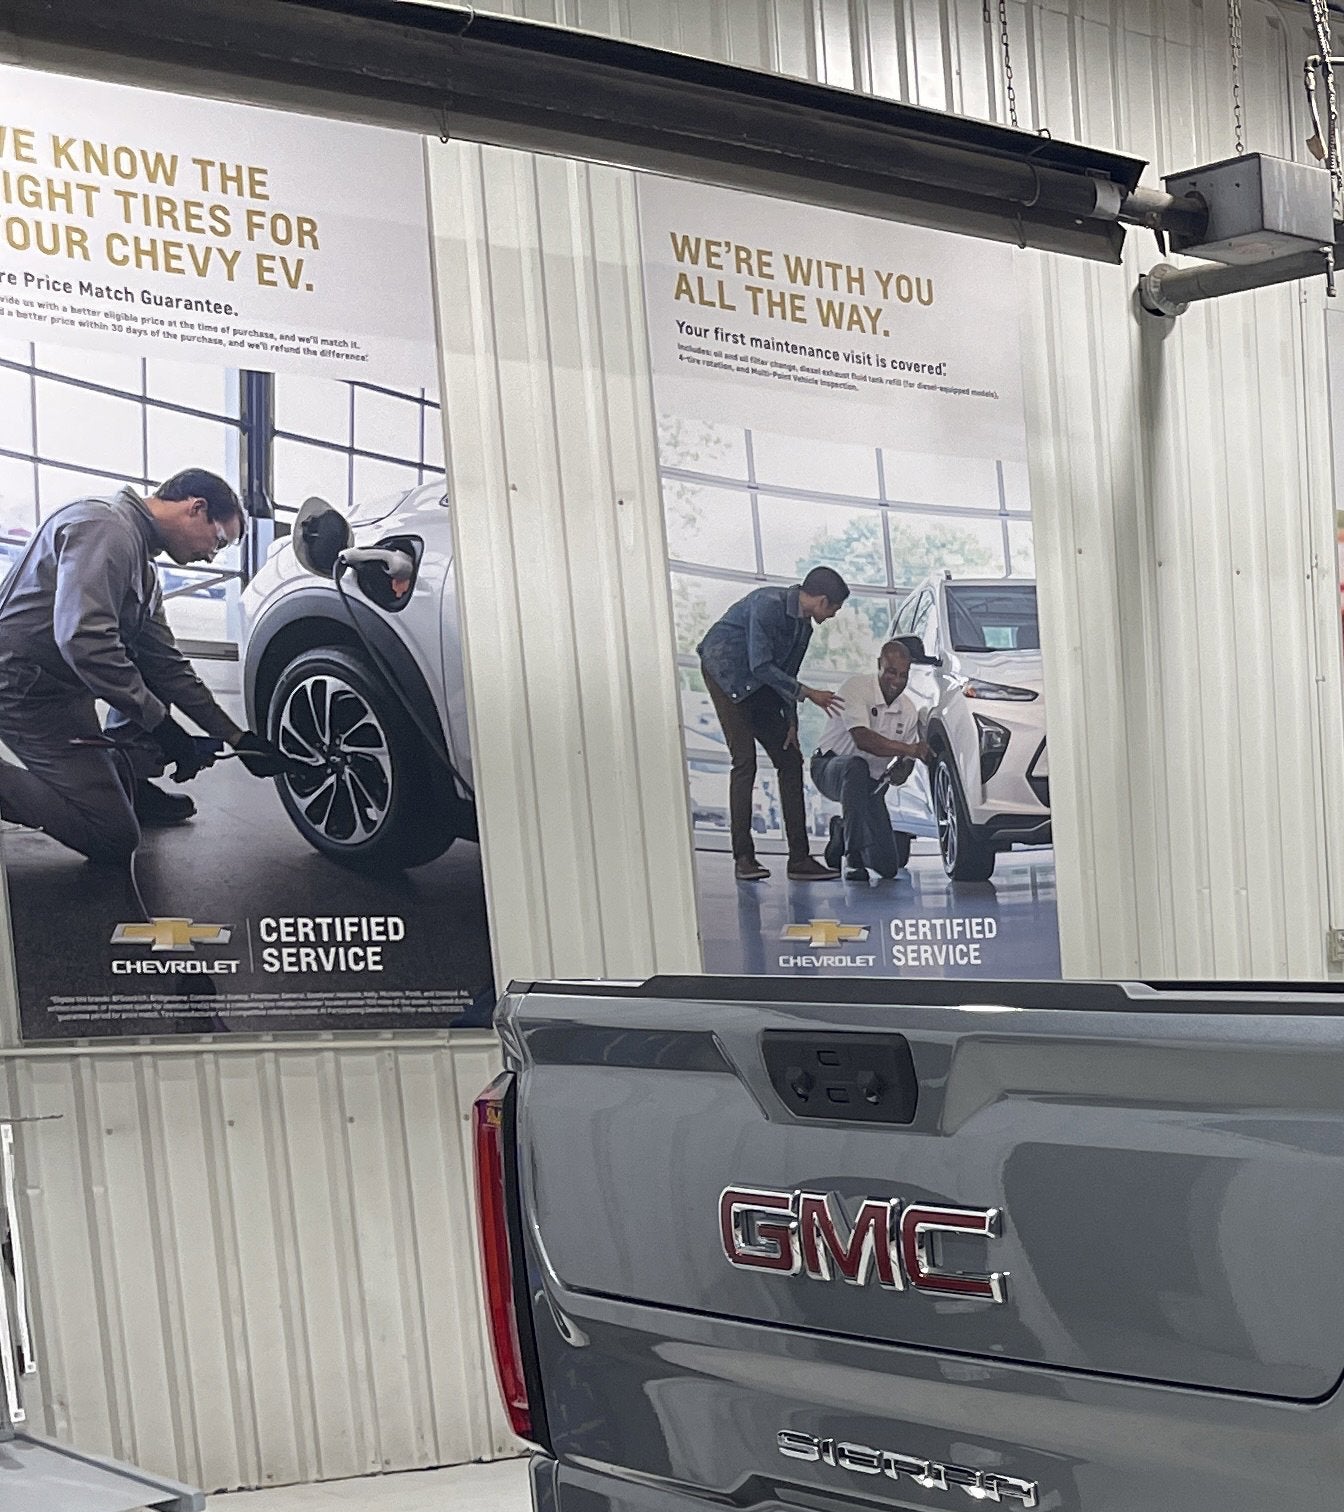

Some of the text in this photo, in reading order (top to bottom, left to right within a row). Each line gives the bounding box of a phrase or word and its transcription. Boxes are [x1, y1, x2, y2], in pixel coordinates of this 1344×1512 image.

[0, 125, 270, 201] E KNOW THE
[114, 189, 232, 239] TIRES
[246, 209, 321, 250] FOR
[0, 214, 314, 292] OUR CHEVY EV.
[24, 271, 73, 294] Price
[79, 280, 135, 303] Match
[141, 290, 239, 316] Guarantee.
[784, 254, 866, 296] WITH
[874, 270, 933, 306] YOU
[37, 301, 60, 312] with
[70, 305, 101, 317] better
[104, 311, 138, 323] eligible
[141, 316, 165, 327] price
[167, 320, 177, 328] at
[179, 320, 195, 330] the
[197, 322, 218, 333] time
[220, 326, 230, 334] of
[232, 328, 277, 341] purchase,
[279, 333, 296, 342] and
[320, 339, 349, 348] match
[674, 272, 890, 337] ALL THE WAY.
[16, 309, 47, 321] better
[50, 316, 75, 326] price
[78, 320, 109, 331] within
[111, 323, 124, 333] 30
[125, 325, 148, 337] days
[150, 328, 160, 337] of
[162, 330, 178, 340] the
[180, 334, 226, 347] purchase,
[228, 339, 245, 348] and
[270, 344, 301, 355] refund
[303, 347, 318, 356] the
[675, 319, 710, 339] Your
[714, 327, 747, 345] first
[750, 336, 840, 361] maintenance
[842, 350, 872, 366] visit
[876, 353, 887, 368] is
[259, 916, 406, 943] CERTIFIED
[890, 917, 998, 941] CERTIFIED
[111, 959, 240, 975] CHEVROLET
[262, 946, 384, 973] SERVICE
[778, 954, 877, 968] CHEVROLET
[892, 944, 982, 967] SERVICE
[719, 1184, 1010, 1303] GMC
[776, 1429, 1038, 1508] SIERRA
